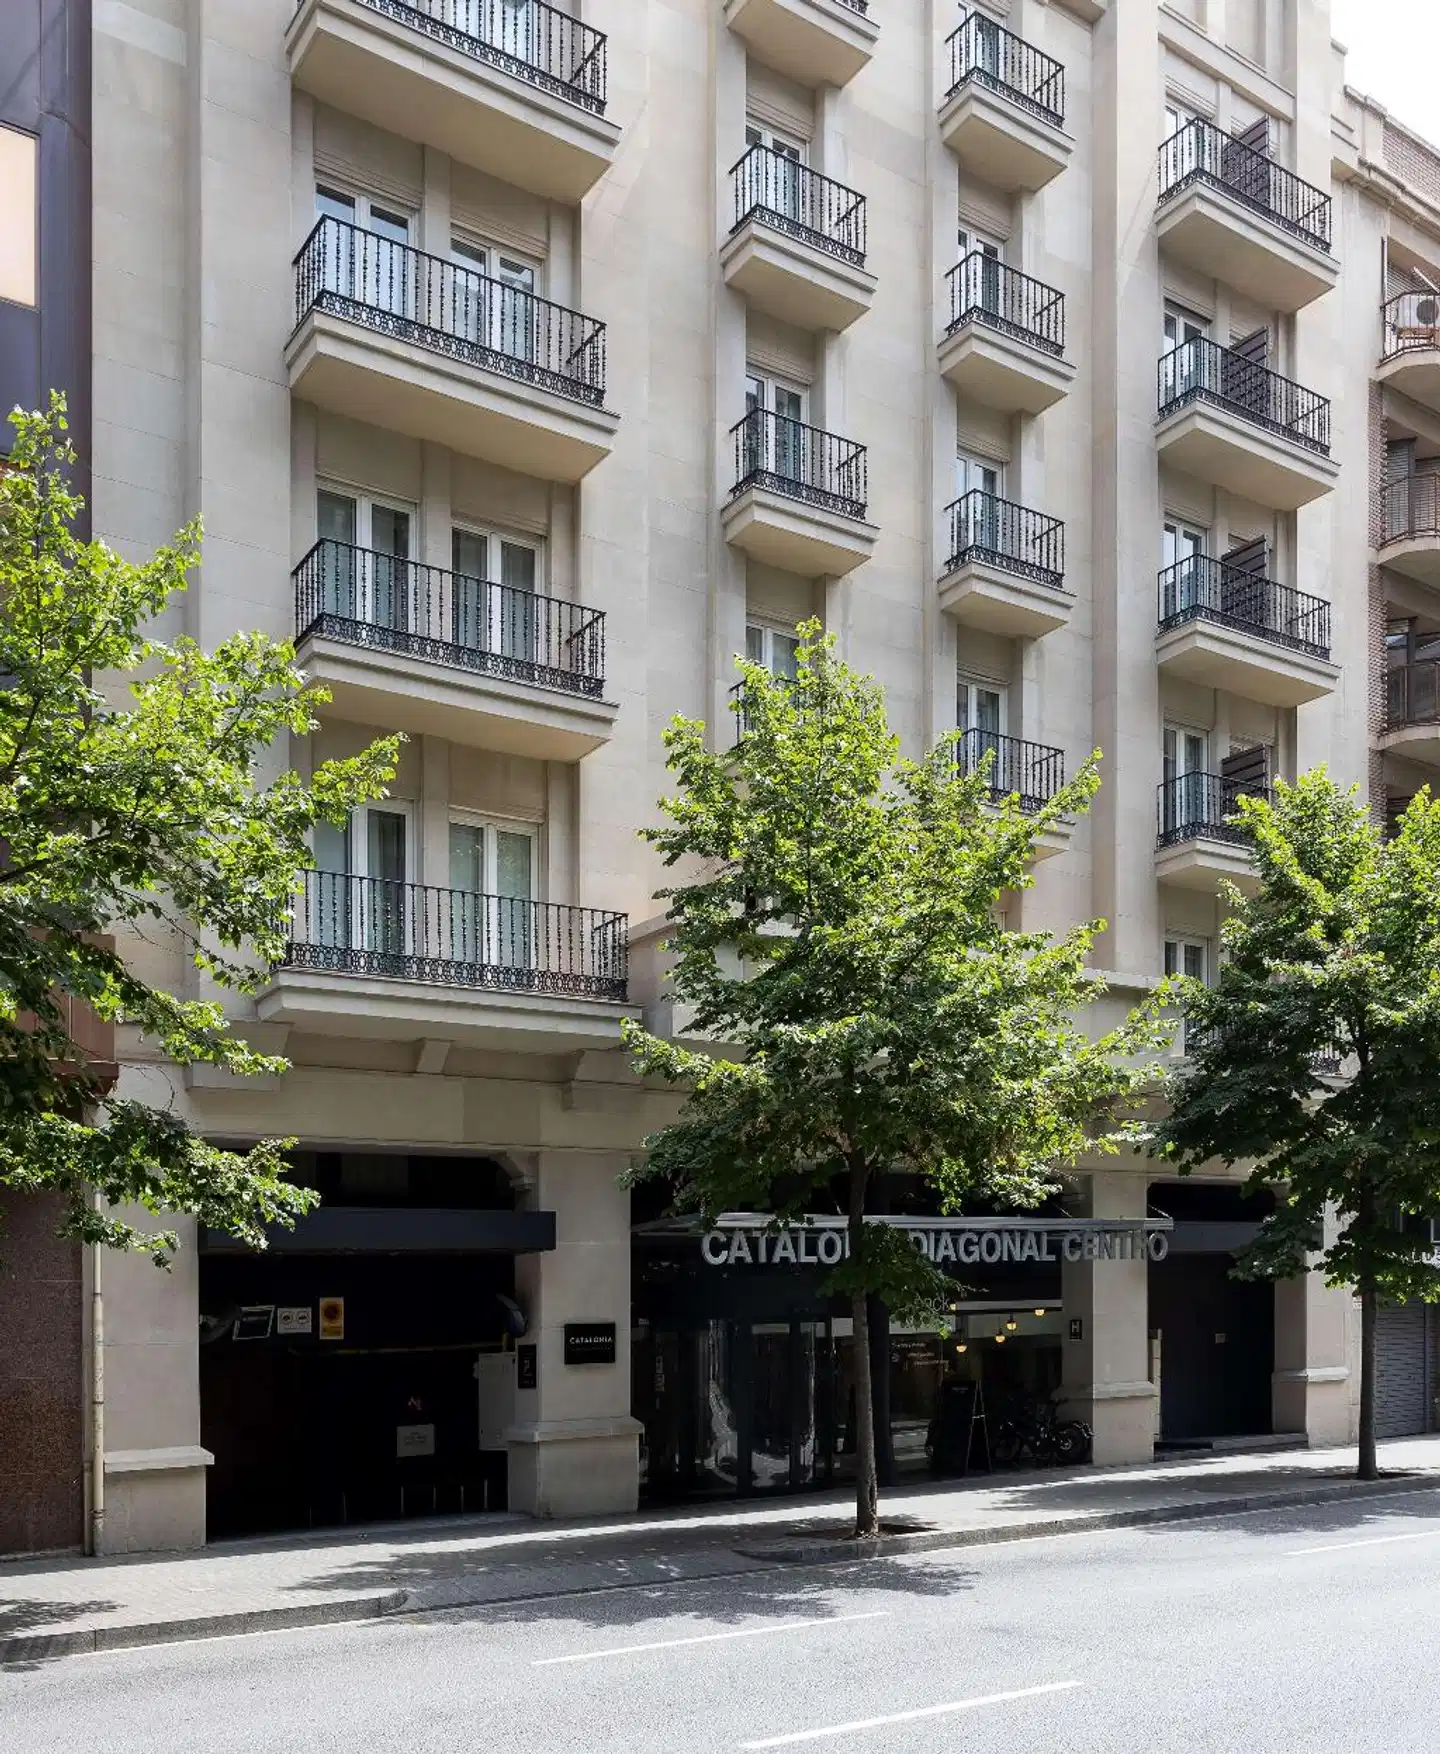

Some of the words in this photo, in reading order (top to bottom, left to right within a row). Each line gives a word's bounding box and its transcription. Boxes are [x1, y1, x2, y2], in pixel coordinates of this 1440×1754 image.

[701, 1230, 851, 1265] CATALO
[1062, 1232, 1169, 1262] CENTRO
[569, 1336, 613, 1345] CATALONIA
